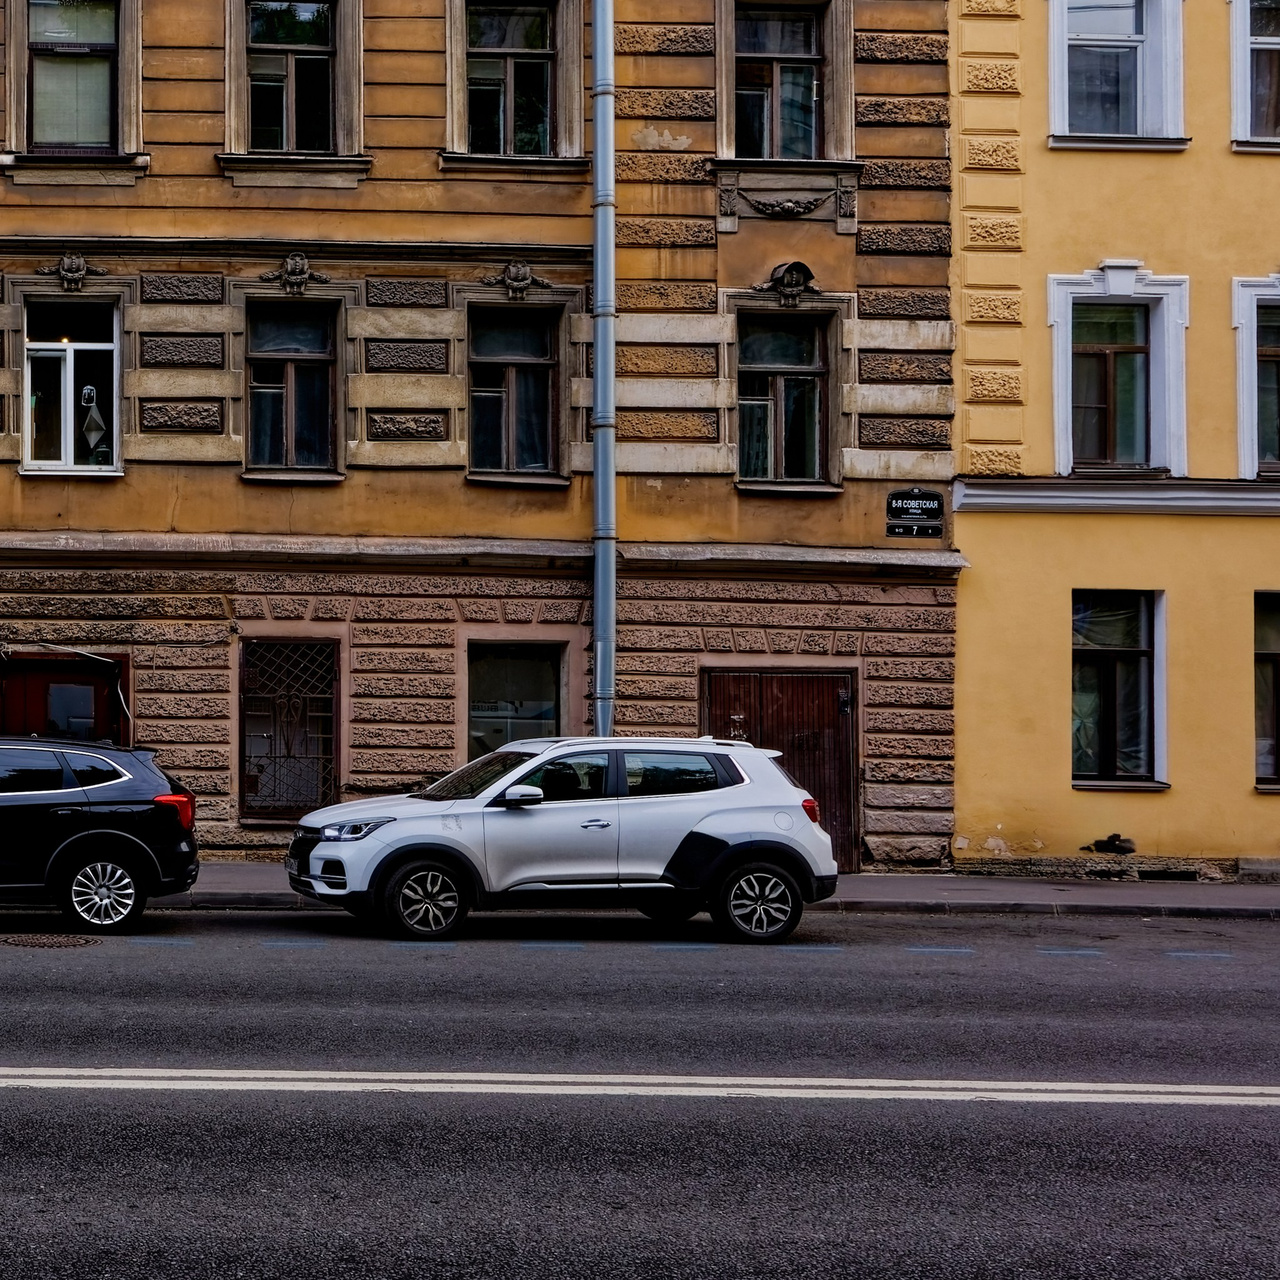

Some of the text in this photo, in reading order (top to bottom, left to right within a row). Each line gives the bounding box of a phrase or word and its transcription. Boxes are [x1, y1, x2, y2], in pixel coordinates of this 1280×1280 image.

[892, 500, 938, 508] 8-Я СОВЕТСКАЯ
[913, 526, 918, 535] 7
